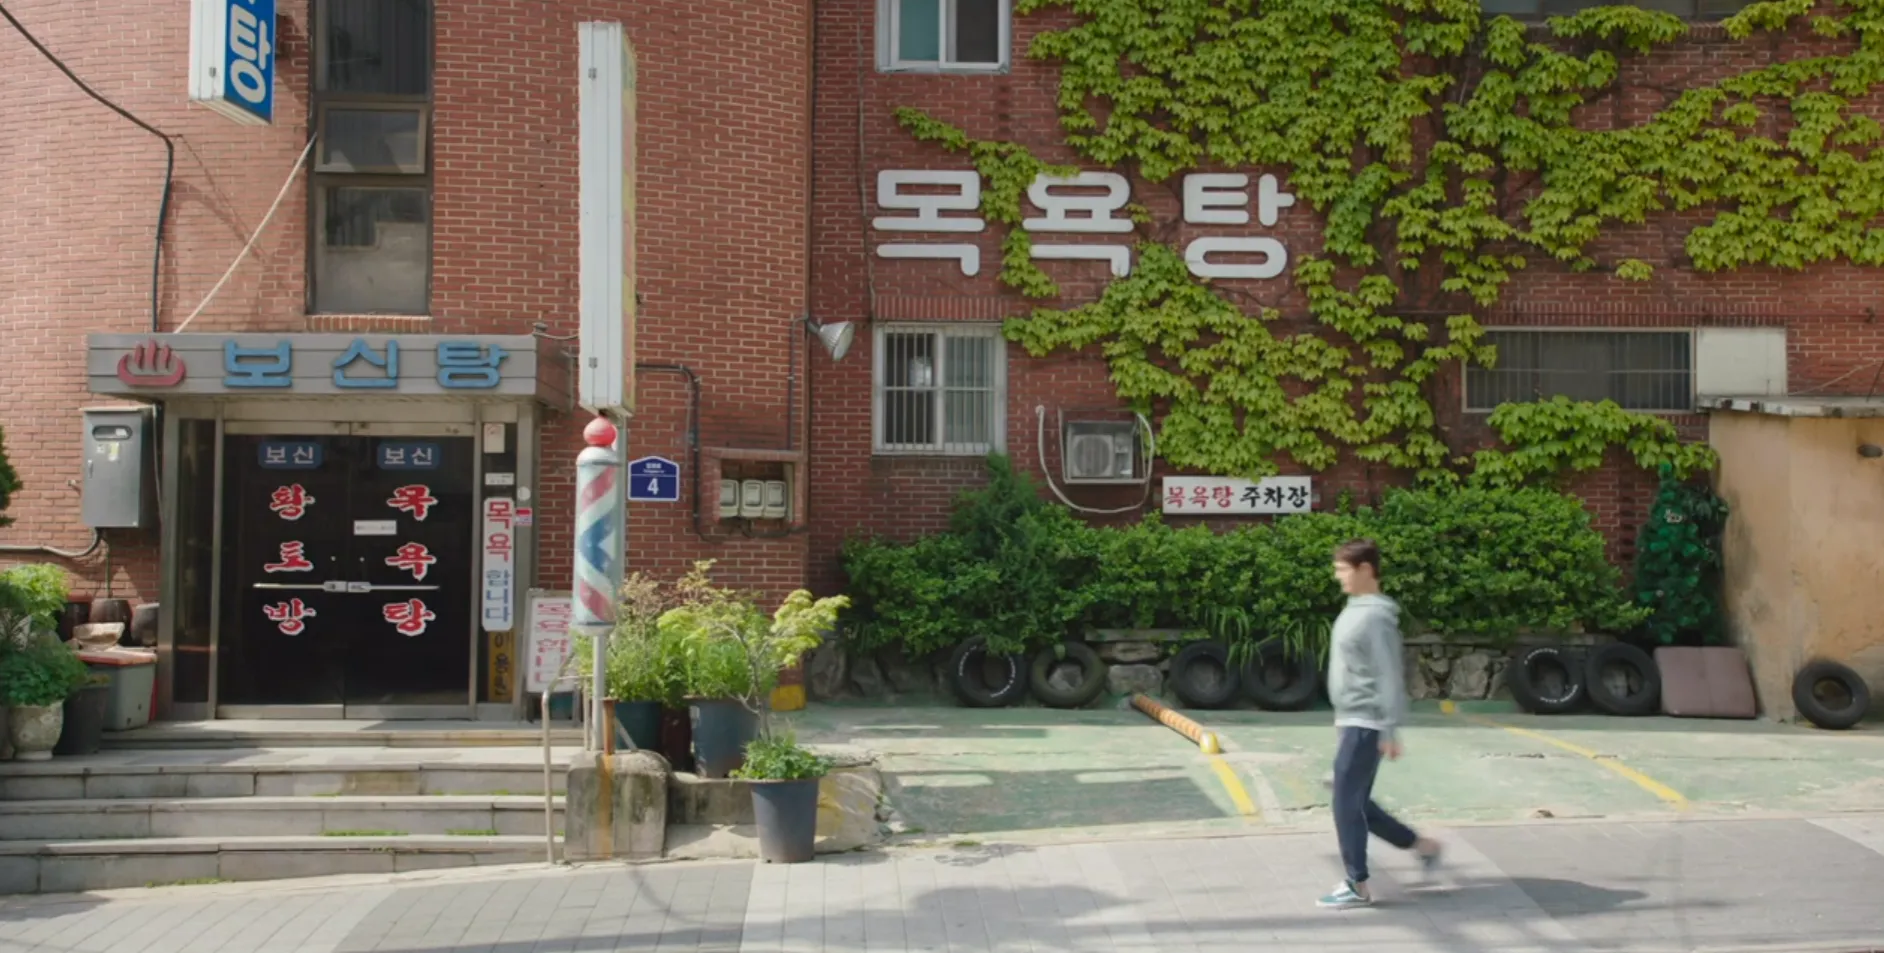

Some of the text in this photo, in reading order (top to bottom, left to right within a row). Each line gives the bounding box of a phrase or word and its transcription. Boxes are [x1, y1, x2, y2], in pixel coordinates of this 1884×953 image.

[230, 0, 271, 103] 탕
[872, 169, 1295, 278] 목욕탕
[223, 338, 510, 388] 보신탕
[265, 446, 314, 464] 보신
[384, 447, 432, 466] 보신
[647, 477, 660, 496] 4
[1165, 485, 1308, 508] 목욕탕 주차장
[263, 484, 317, 636] 황토방
[383, 485, 438, 636] 목욕탕
